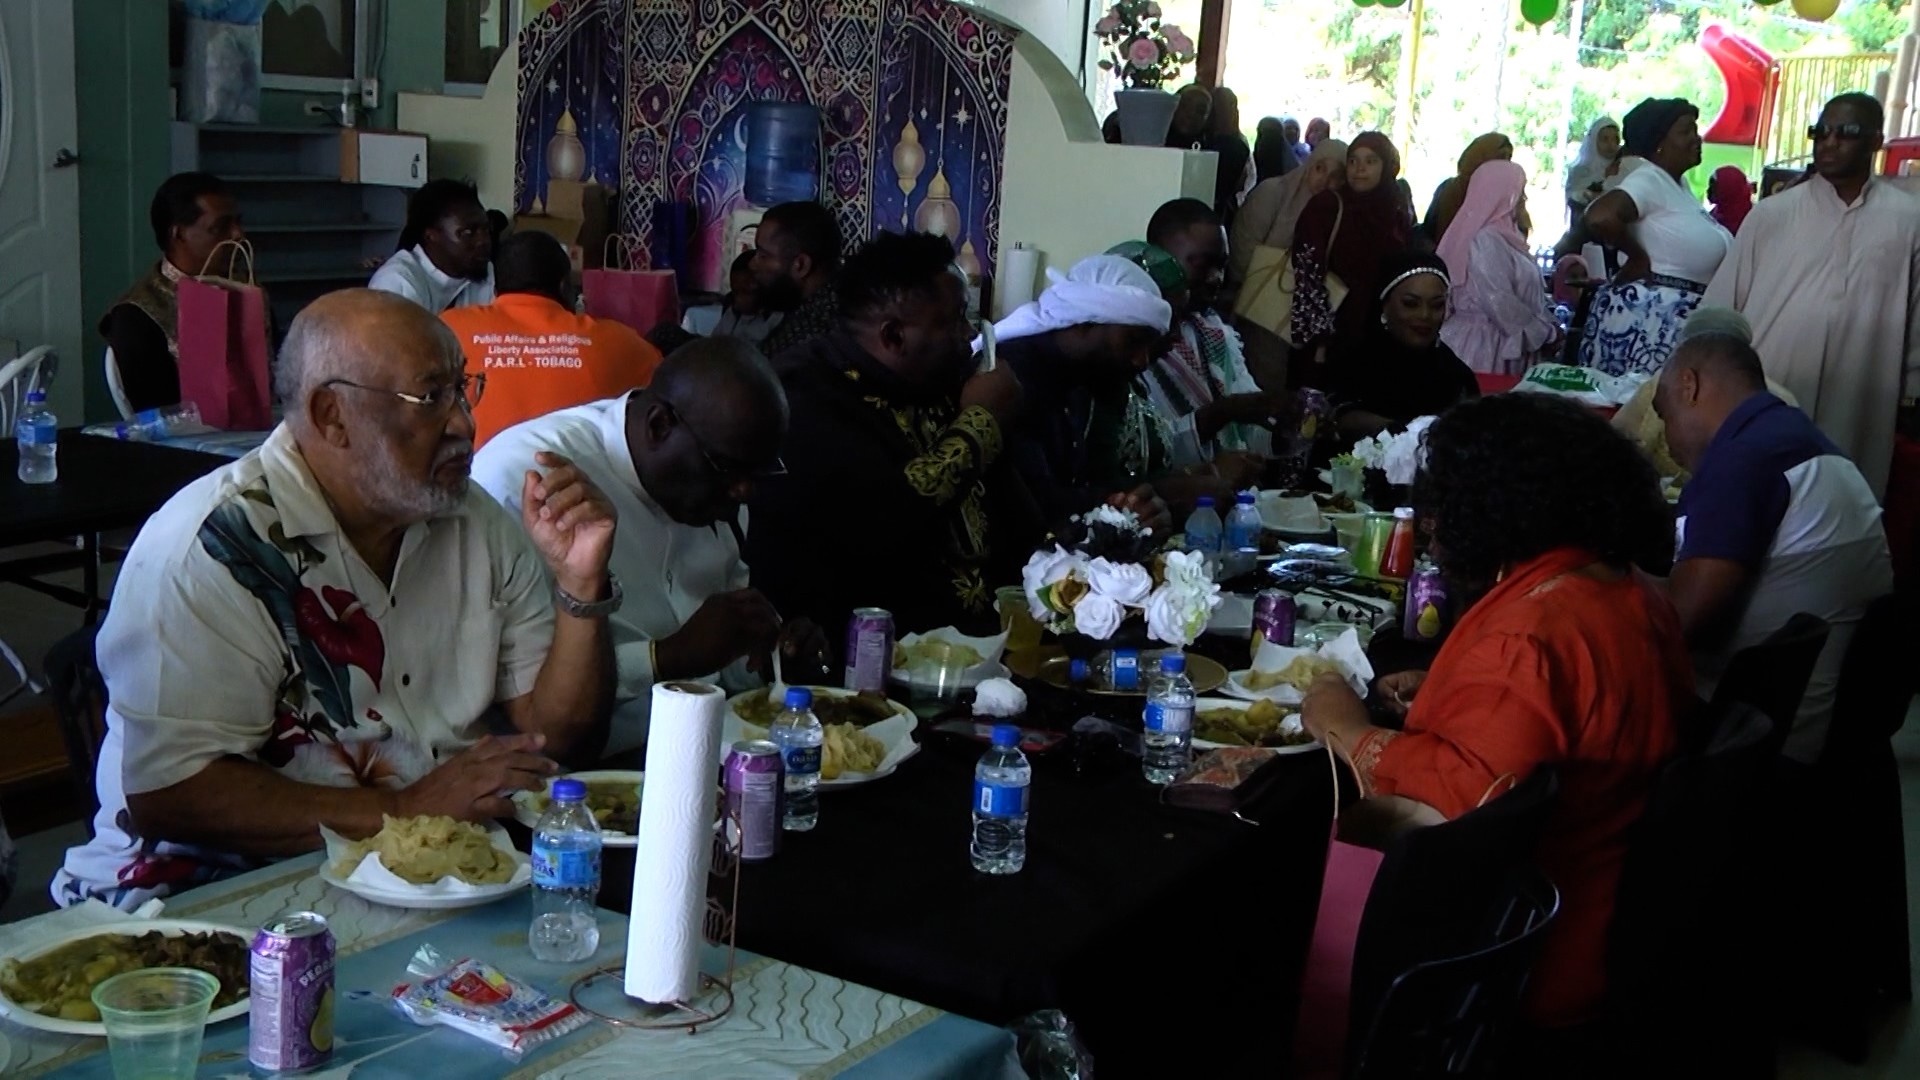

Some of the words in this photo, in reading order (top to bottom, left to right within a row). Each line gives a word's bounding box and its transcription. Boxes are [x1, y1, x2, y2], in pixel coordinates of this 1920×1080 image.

[473, 334, 503, 344] Public
[503, 334, 536, 344] Affairs
[538, 335, 547, 344] &
[548, 334, 592, 346] Religious
[488, 345, 520, 355] Liberty
[522, 345, 579, 354] Association
[534, 356, 583, 369] TOBAGO
